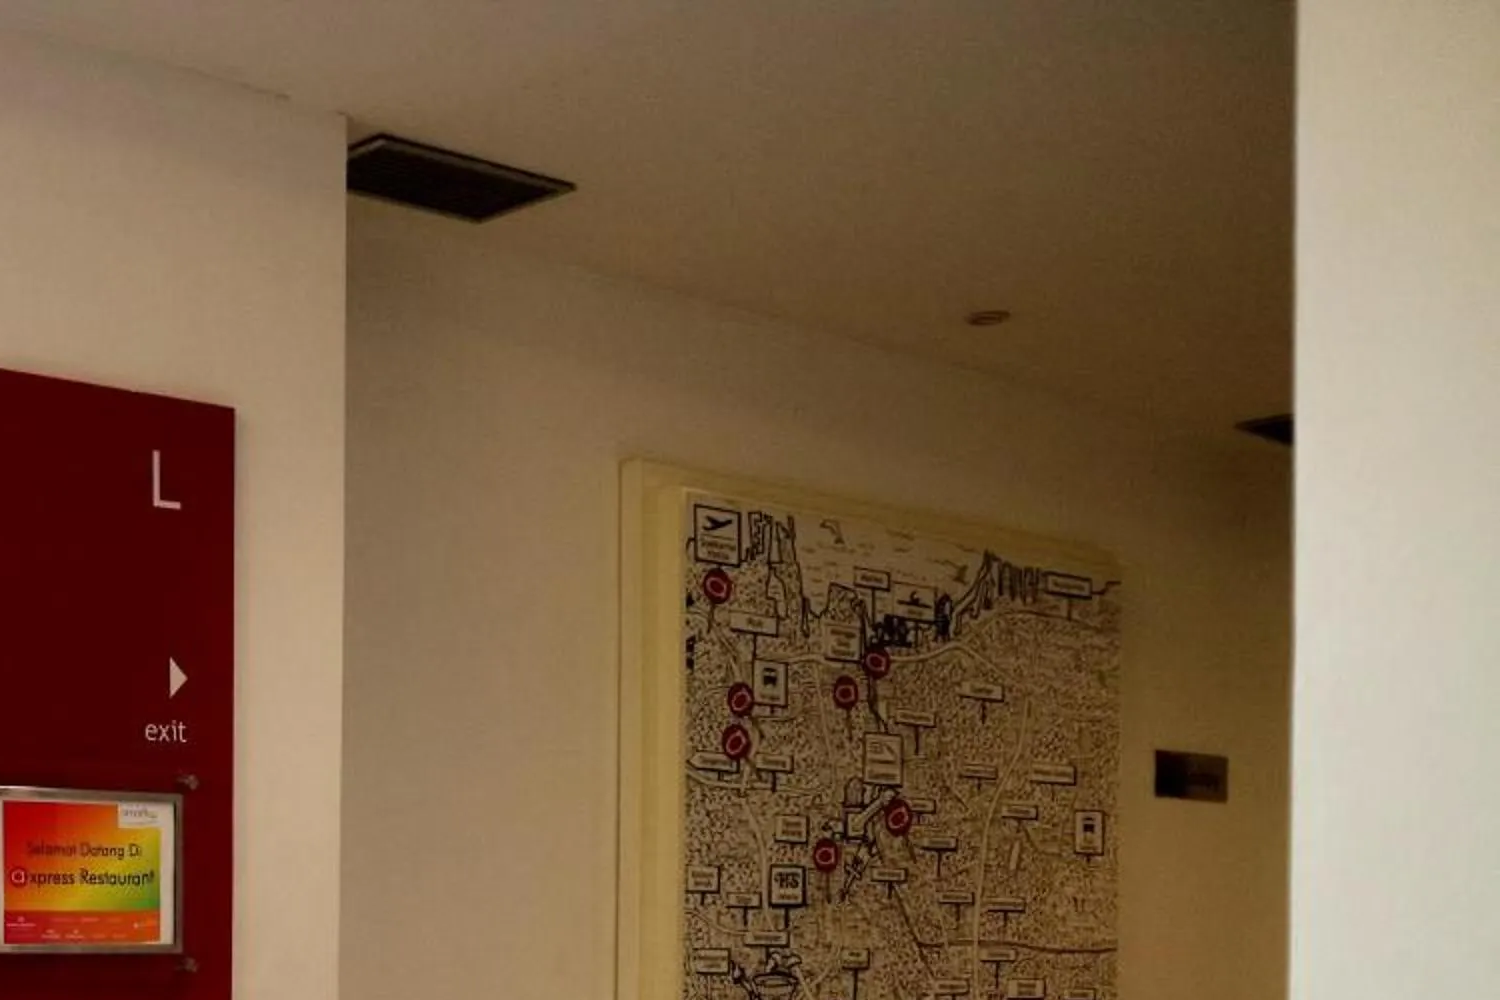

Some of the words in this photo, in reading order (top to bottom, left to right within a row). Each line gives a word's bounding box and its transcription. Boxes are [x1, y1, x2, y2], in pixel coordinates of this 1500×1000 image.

[152, 450, 181, 510] L
[144, 719, 188, 743] exit
[80, 842, 124, 860] Datang
[80, 868, 155, 885] Restaurant
